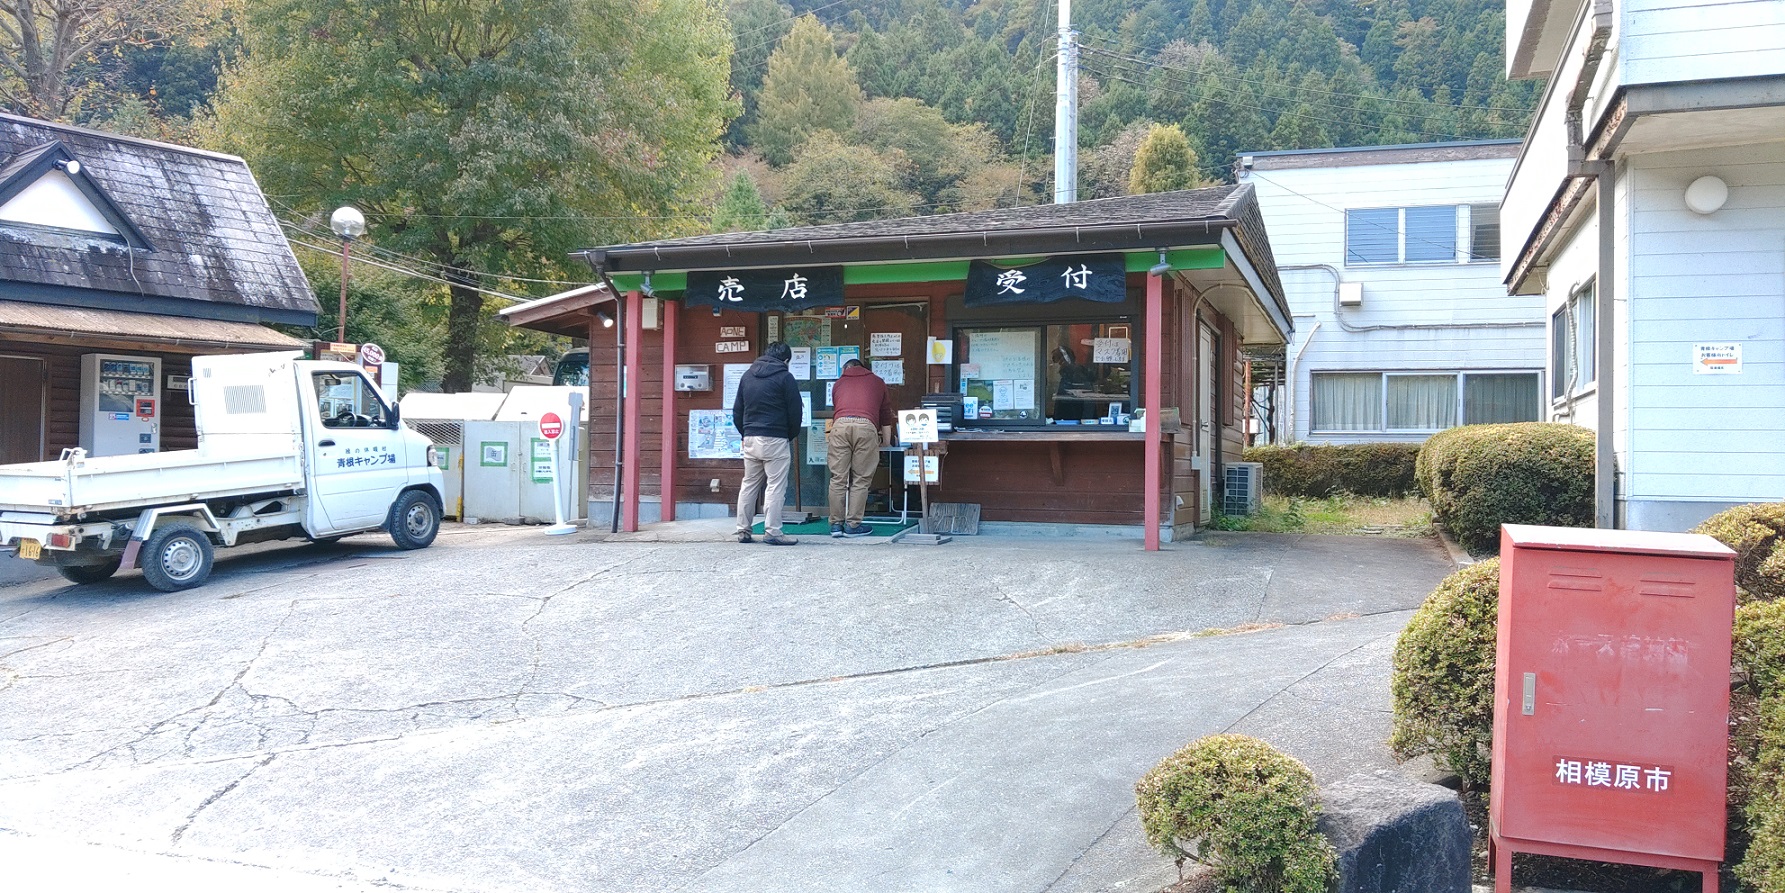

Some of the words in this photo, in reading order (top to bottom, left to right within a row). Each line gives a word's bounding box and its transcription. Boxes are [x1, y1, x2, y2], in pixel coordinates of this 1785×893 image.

[717, 272, 809, 302] 売店
[996, 263, 1093, 296] 受付
[716, 341, 746, 352] CAMP
[336, 453, 396, 468] 青根キャンプ場
[1555, 758, 1673, 793] 相模原市
